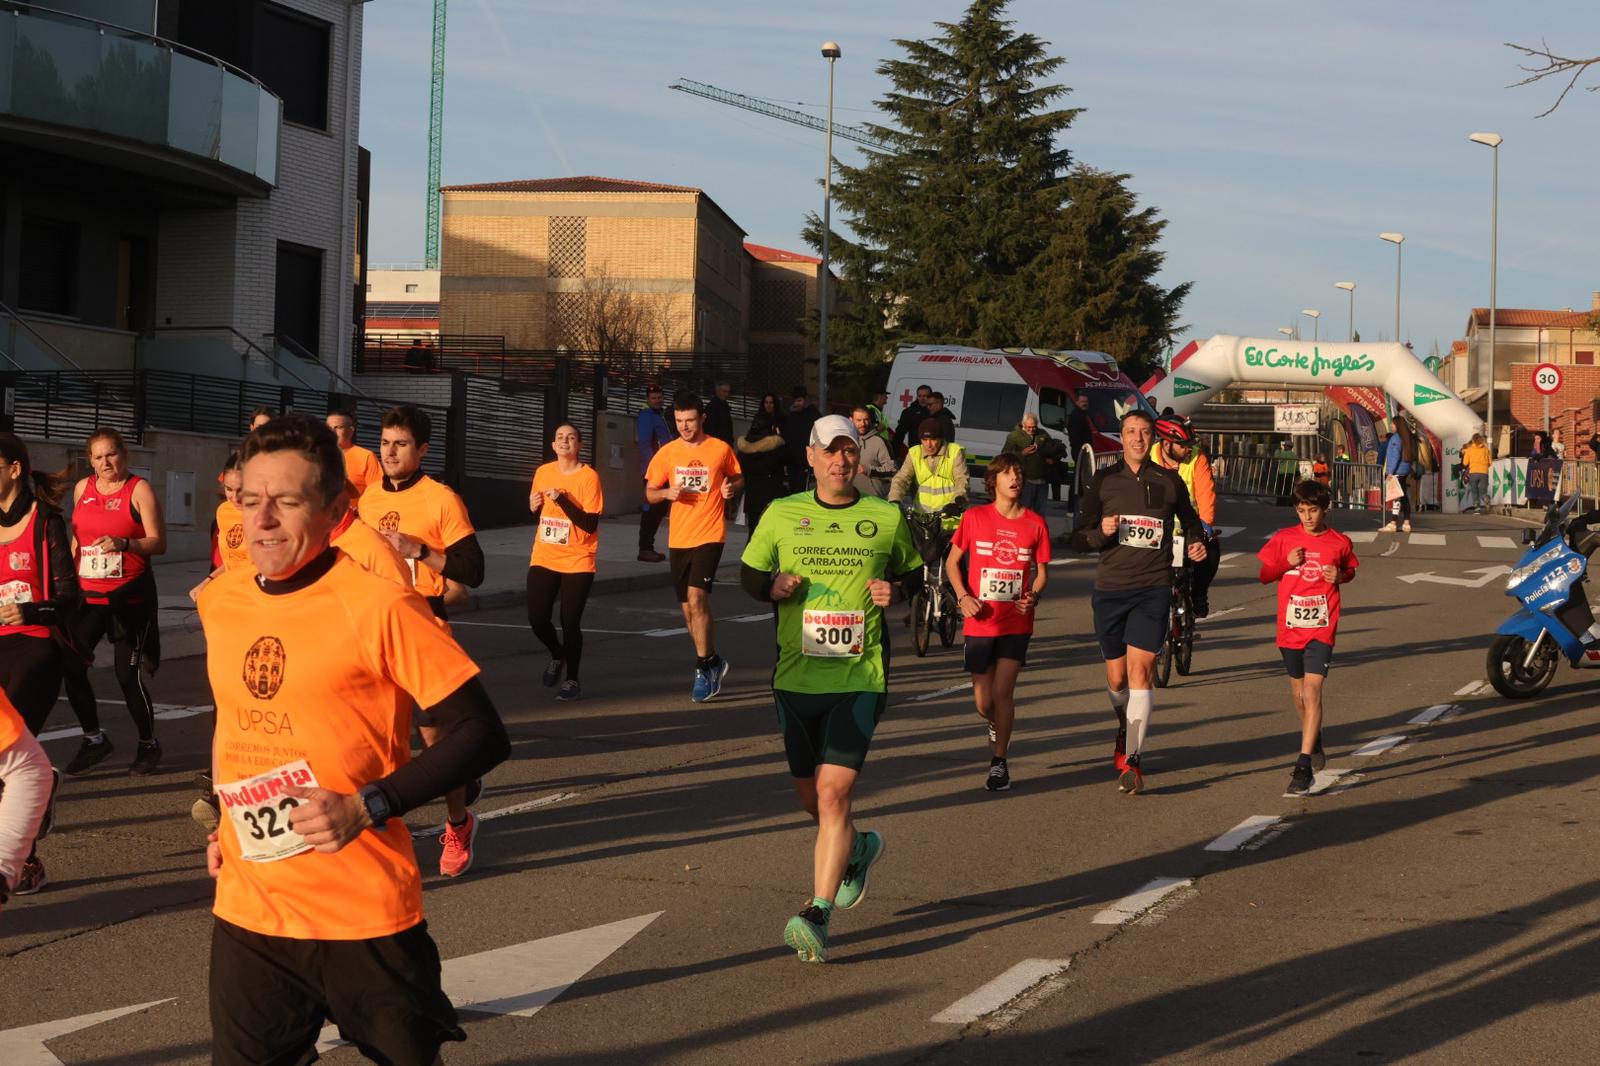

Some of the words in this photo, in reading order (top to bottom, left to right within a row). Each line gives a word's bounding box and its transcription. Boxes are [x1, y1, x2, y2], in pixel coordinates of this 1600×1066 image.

[951, 356, 1003, 366] AMBULANCIA
[1244, 346, 1263, 367] El
[1265, 348, 1310, 369] Corte
[1310, 346, 1376, 378] Inglés
[1538, 373, 1557, 385] 30
[943, 394, 956, 407] oja
[681, 476, 702, 487] 125
[1128, 526, 1155, 540] 590
[792, 546, 875, 558] CORRECAMINOS
[801, 557, 864, 568] CARBAJOSA
[810, 568, 854, 576] SALAMANCA
[1542, 565, 1564, 584] 112
[989, 579, 1015, 594] 521
[1294, 607, 1320, 621] 522
[815, 627, 852, 645] 300
[236, 706, 294, 737] UPSA
[225, 741, 271, 754] CORREMOS
[272, 745, 308, 760] JUNTOS
[241, 753, 253, 765] LA
